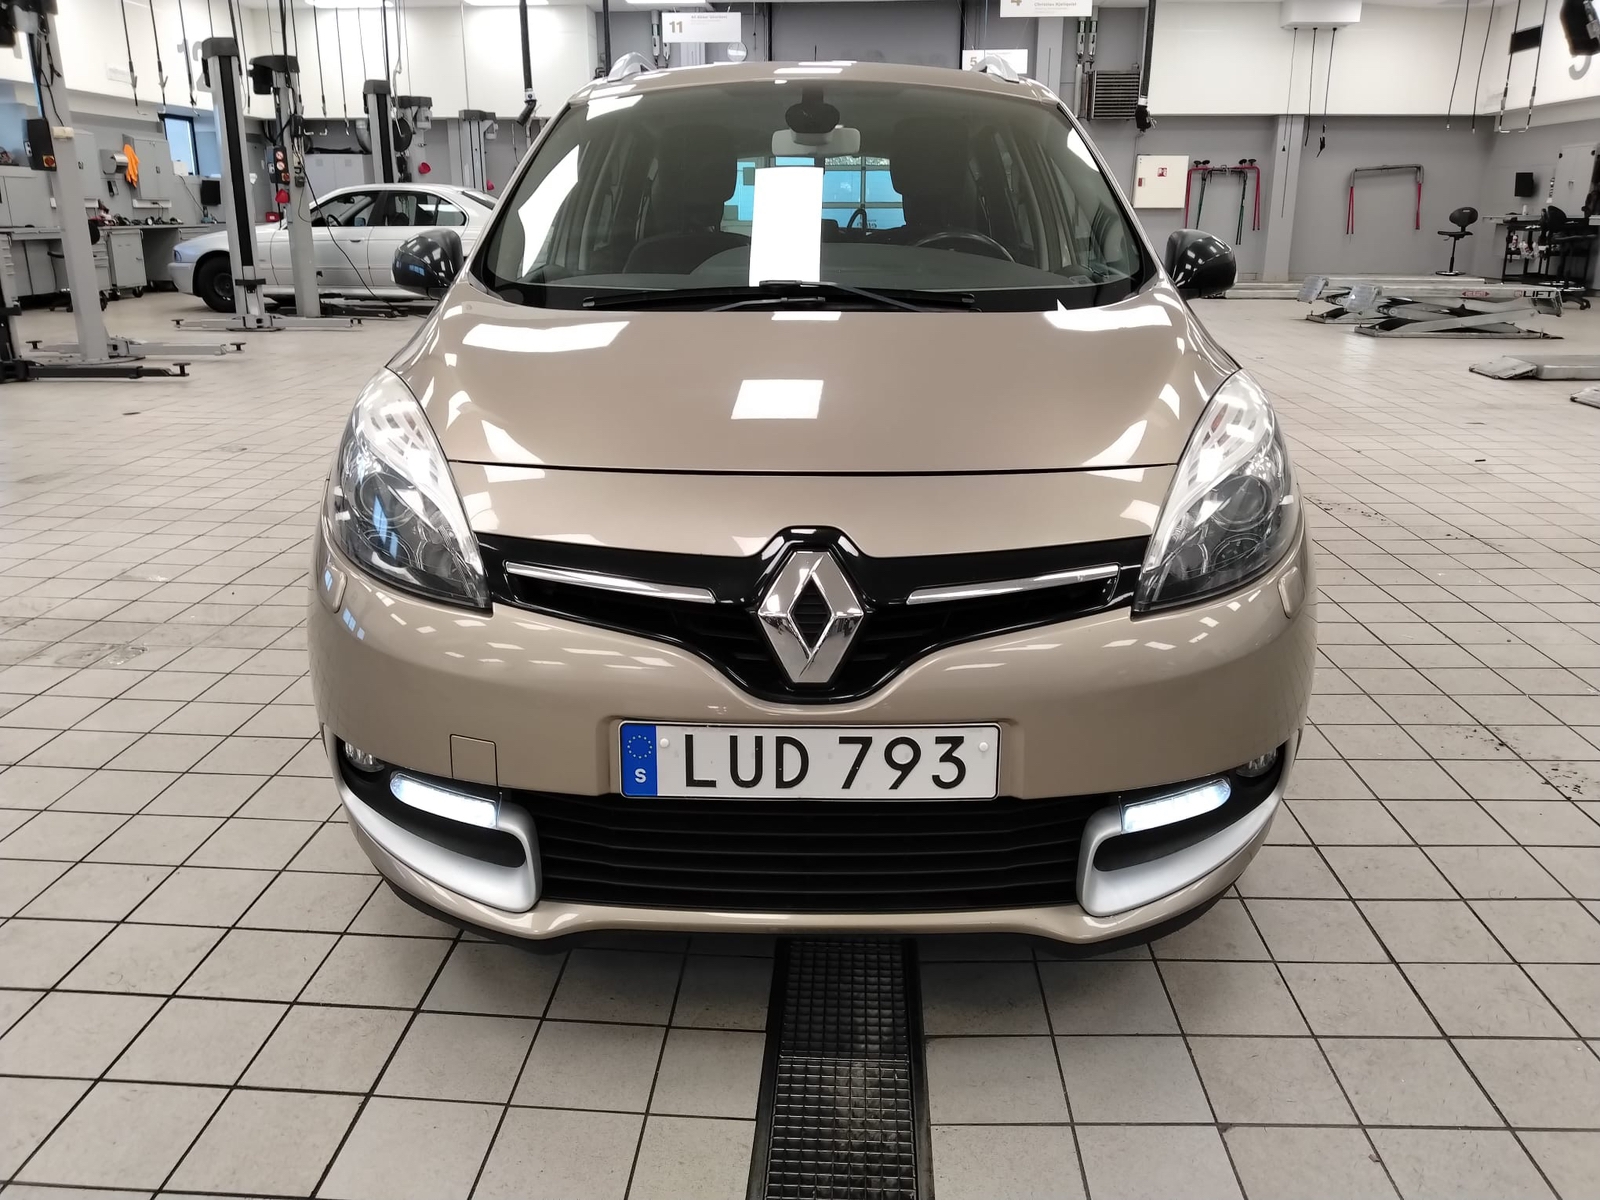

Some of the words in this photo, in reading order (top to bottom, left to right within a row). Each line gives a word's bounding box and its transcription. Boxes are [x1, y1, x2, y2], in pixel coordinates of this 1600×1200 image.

[669, 21, 683, 33] 11
[970, 56, 978, 67] 5
[685, 734, 809, 789] LUD
[838, 736, 966, 790] 793
[634, 768, 647, 783] S
